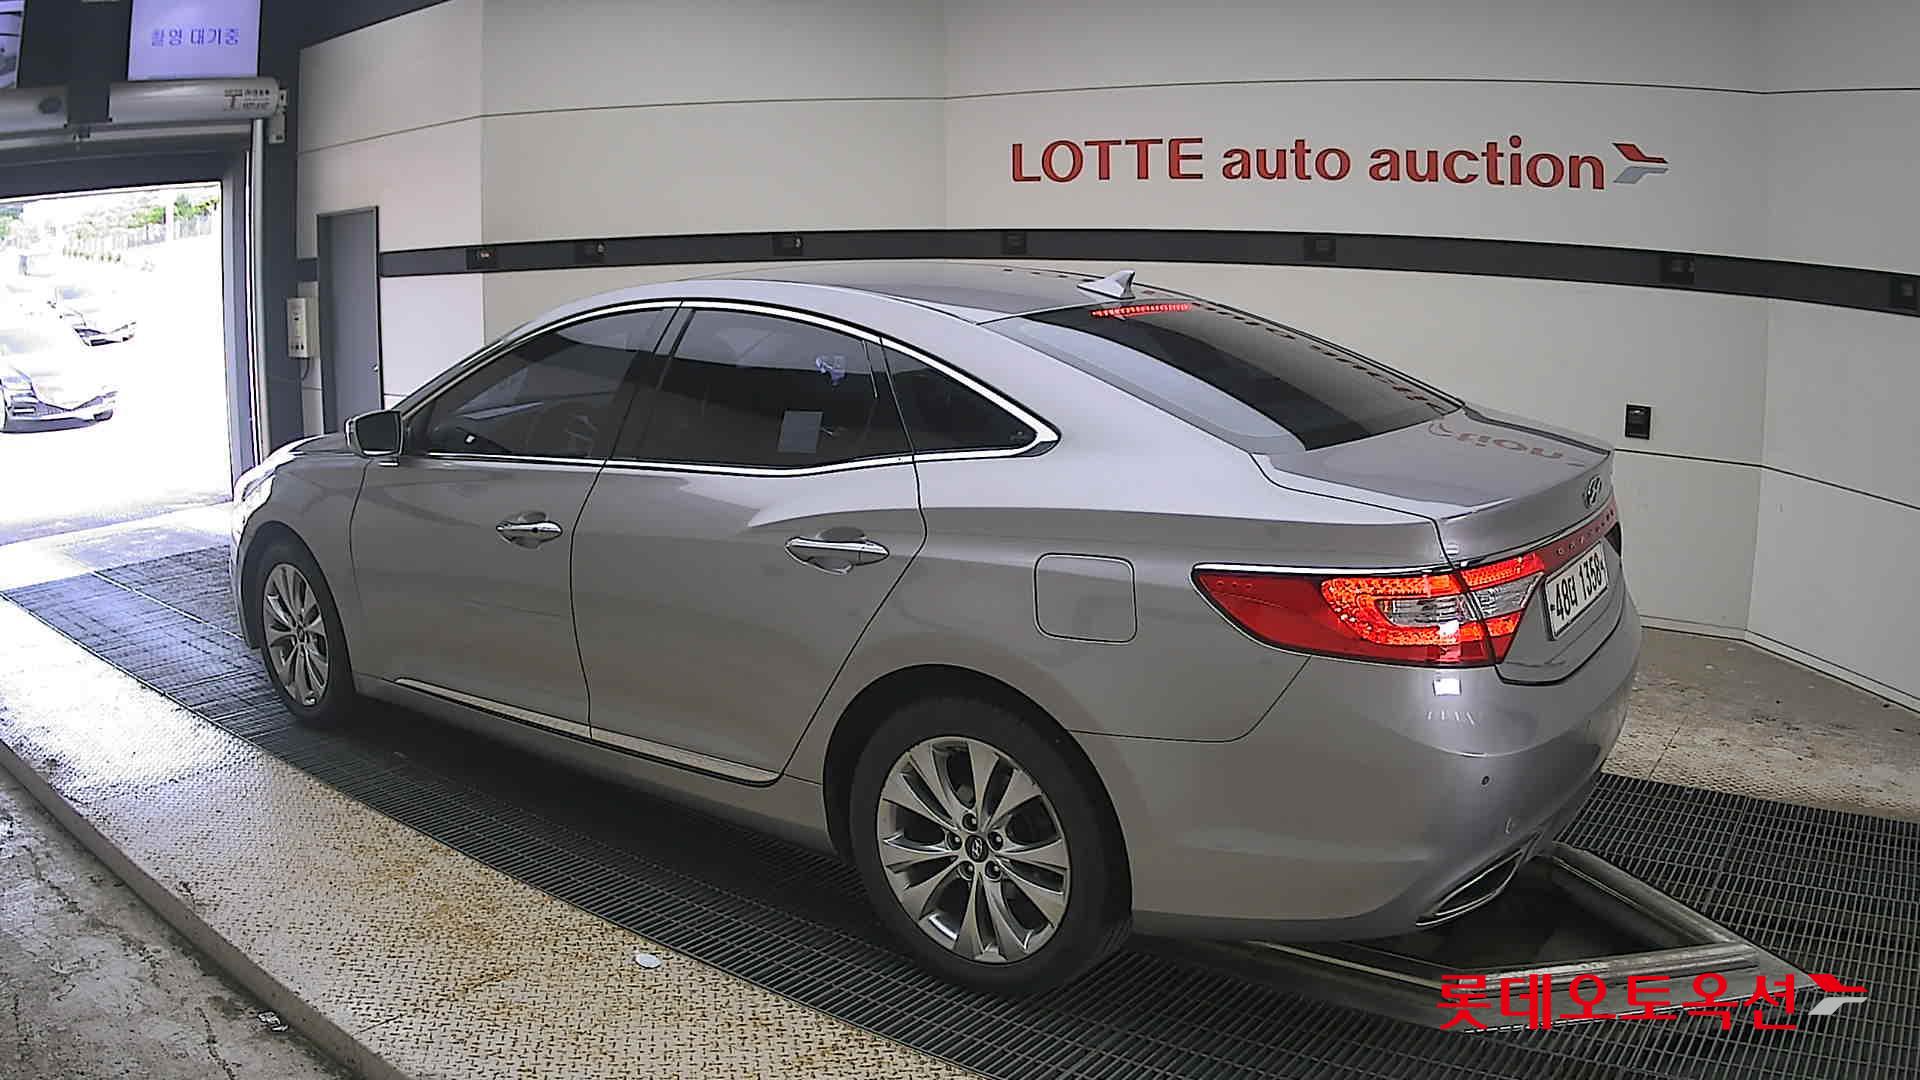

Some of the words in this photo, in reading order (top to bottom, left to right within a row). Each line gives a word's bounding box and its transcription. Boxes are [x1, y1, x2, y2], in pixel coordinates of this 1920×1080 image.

[190, 27, 240, 46] 대기중
[1011, 137, 1204, 182] LOTTE
[1221, 139, 1350, 181] auto
[1368, 136, 1605, 190] auction
[1578, 552, 1603, 601] 1358
